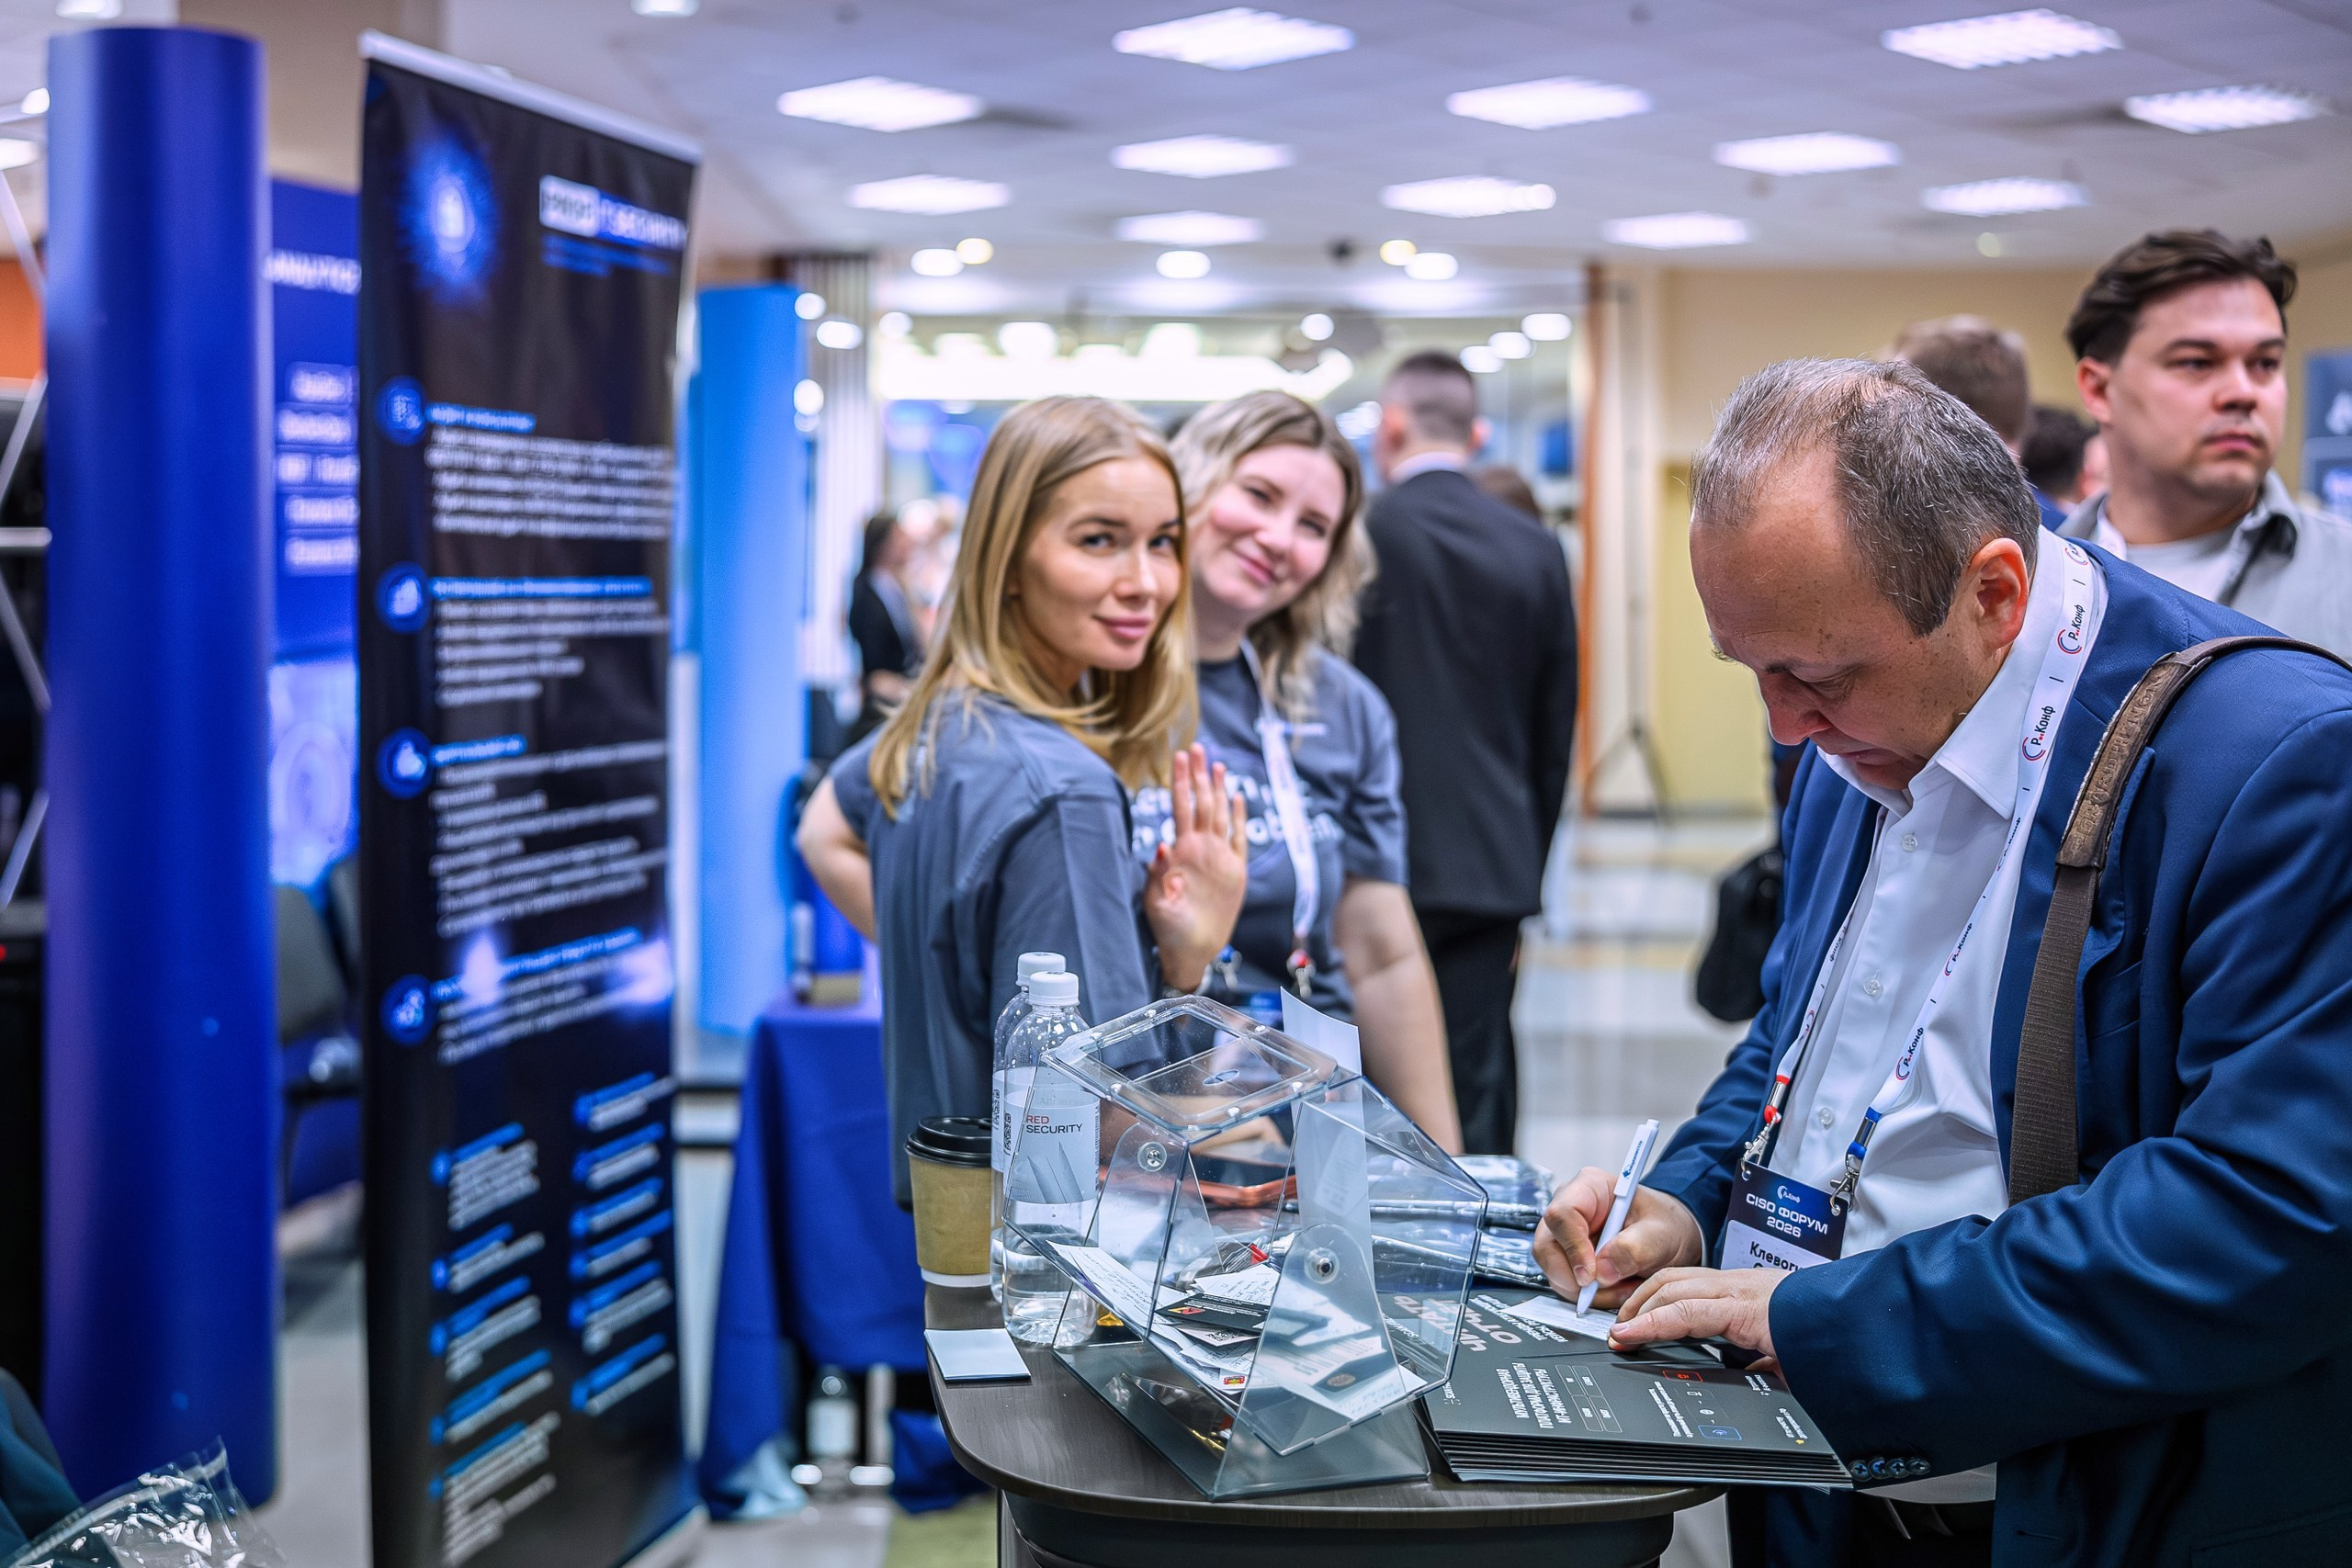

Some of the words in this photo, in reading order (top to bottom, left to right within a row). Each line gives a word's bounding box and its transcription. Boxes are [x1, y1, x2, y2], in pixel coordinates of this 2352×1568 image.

[1025, 1114, 1050, 1124] RED
[1025, 1122, 1083, 1134] SECURITY
[1746, 1193, 1776, 1213] CISO
[1778, 1207, 1828, 1235] ФОРУМ
[1766, 1216, 1802, 1237] 2026
